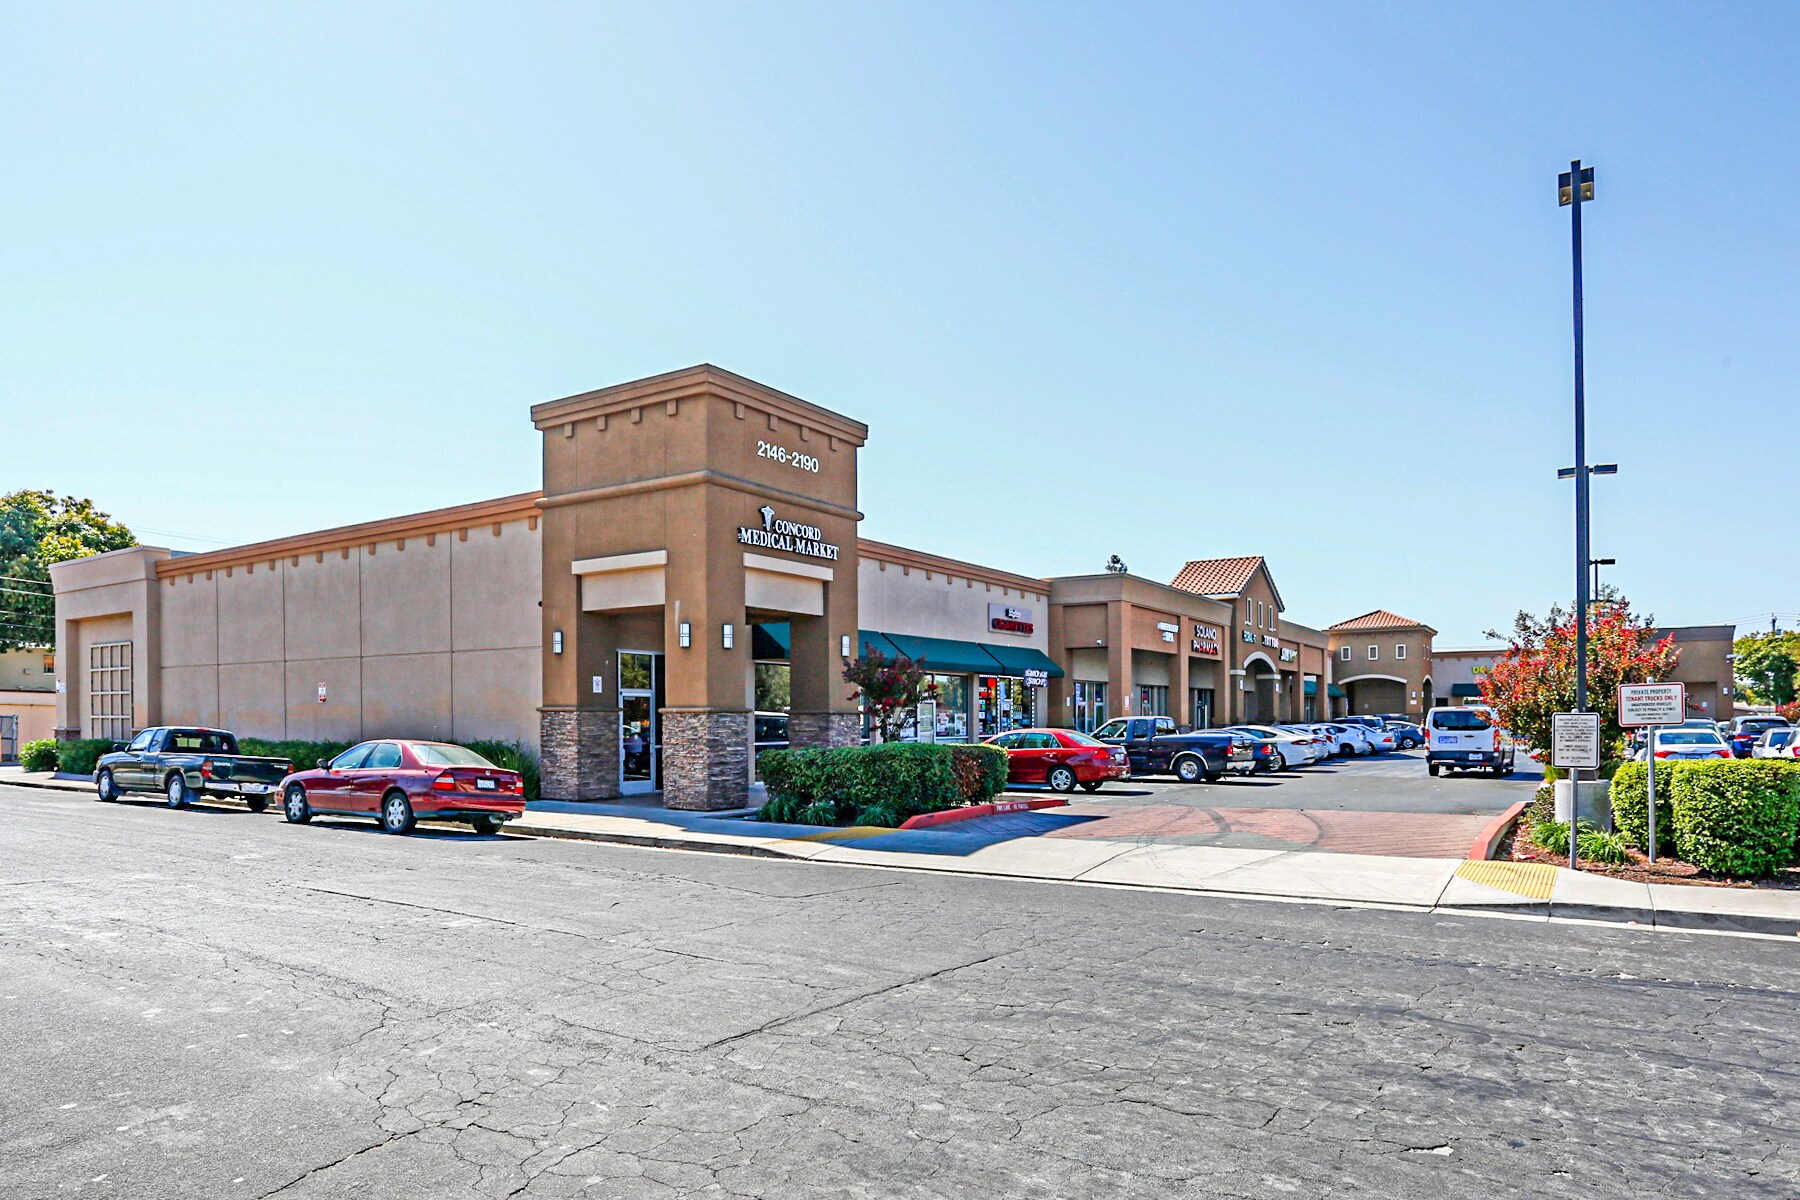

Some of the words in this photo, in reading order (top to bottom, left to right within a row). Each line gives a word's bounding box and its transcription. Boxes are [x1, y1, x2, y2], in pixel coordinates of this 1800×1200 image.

[757, 440, 819, 473] 2146-2190
[740, 527, 793, 553] MEDICAL
[795, 538, 840, 561] MARKET
[775, 520, 821, 541] CONCORD
[1196, 624, 1217, 641] SOLANO
